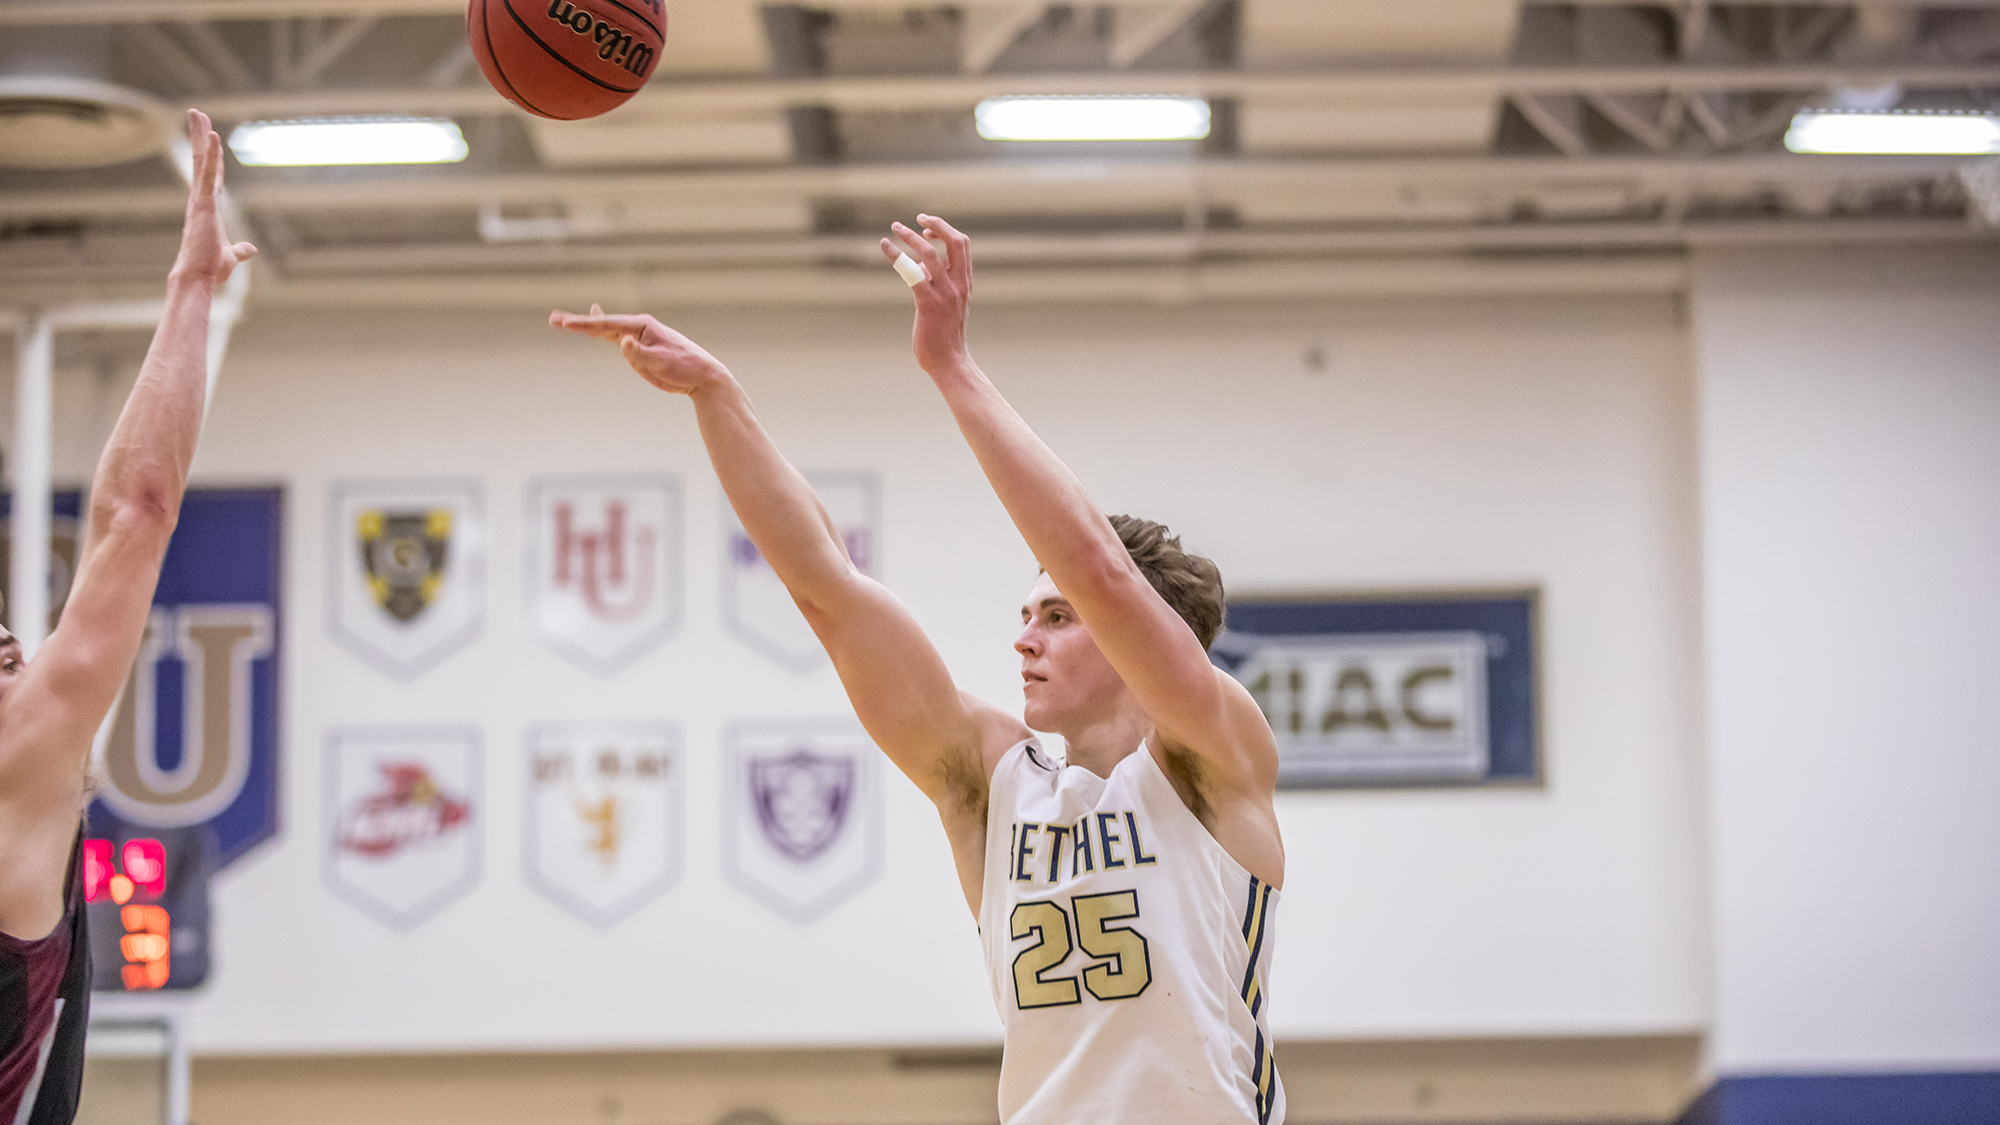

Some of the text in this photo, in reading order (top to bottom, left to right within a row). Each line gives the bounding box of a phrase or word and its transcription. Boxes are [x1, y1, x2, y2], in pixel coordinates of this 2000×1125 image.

[547, 0, 654, 78] Wilson
[1009, 810, 1158, 885] ETHEL
[1009, 888, 1153, 1010] 25
